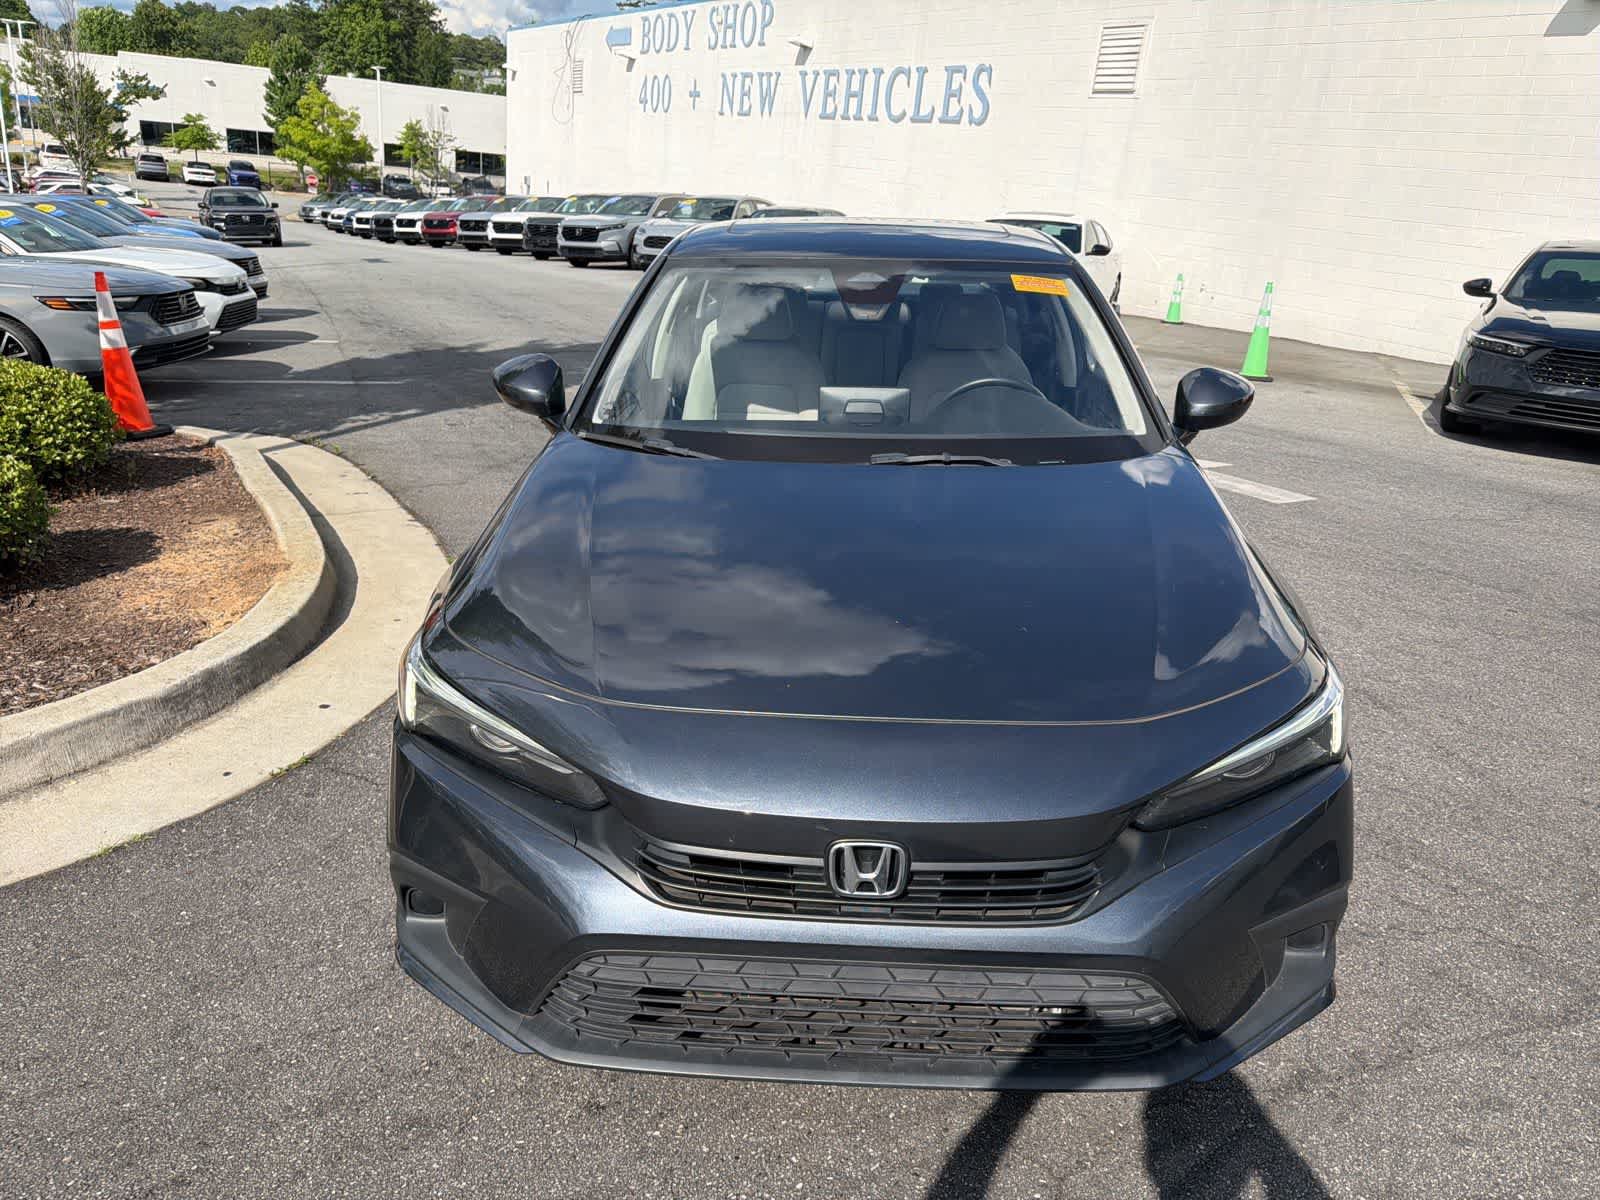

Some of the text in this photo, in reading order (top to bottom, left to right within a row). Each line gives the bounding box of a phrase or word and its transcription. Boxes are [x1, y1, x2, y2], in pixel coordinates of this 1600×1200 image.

[640, 0, 775, 55] BODY SHOP
[638, 74, 672, 113] 400
[718, 71, 782, 118] NEW
[799, 63, 993, 127] VEHICLES
